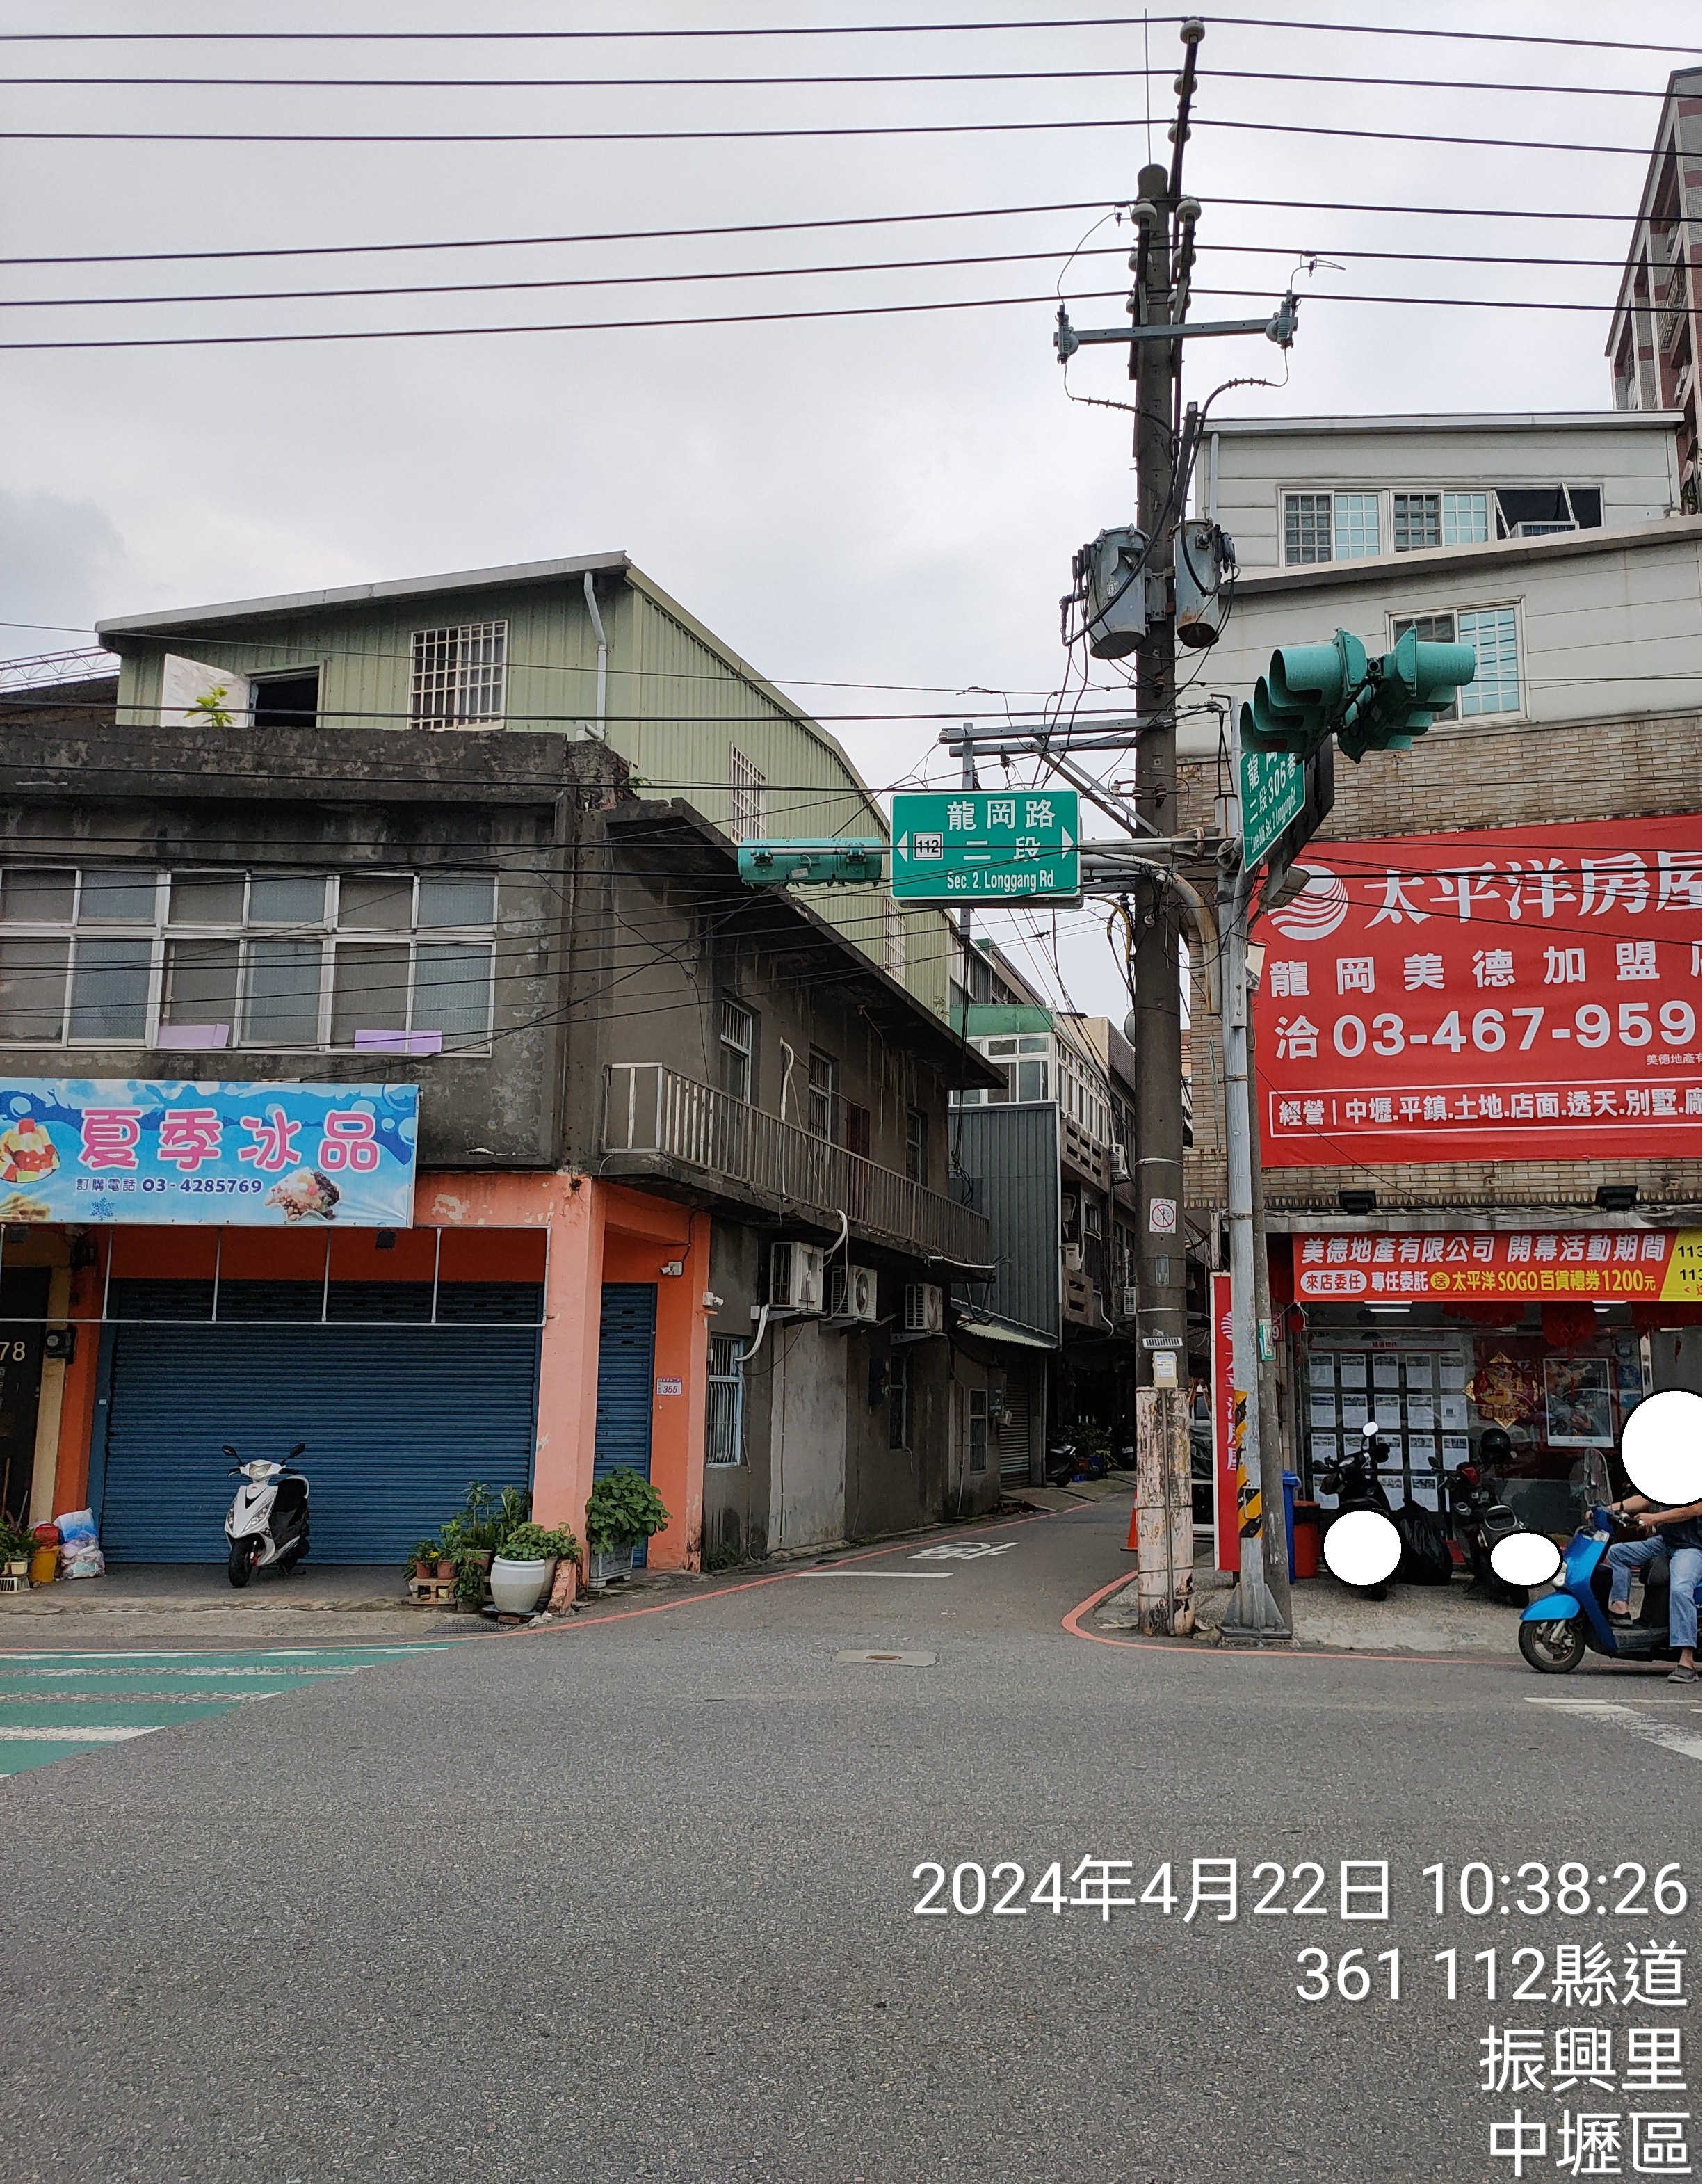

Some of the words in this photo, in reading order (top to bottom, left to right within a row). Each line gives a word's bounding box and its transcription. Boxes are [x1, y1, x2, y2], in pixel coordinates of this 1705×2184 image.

[947, 799, 1056, 830] 龍岡路
[917, 840, 939, 853] 112
[963, 836, 1041, 862] 二段
[947, 872, 969, 890] Sec.
[973, 871, 982, 890] 2,
[985, 871, 1037, 892] Longgang
[1040, 869, 1056, 888] Rd.
[1364, 851, 1702, 929] 太平洋房屋
[1270, 940, 1702, 997] 龍岡美德加盟
[78, 1109, 381, 1173] 夏季冰品
[76, 1178, 136, 1192] 訂購電話
[142, 1178, 264, 1194] 03-4285769
[1301, 1237, 1494, 1264] 美德地產有限公司
[1507, 1235, 1666, 1262] 開幕活動期間
[1306, 1274, 1361, 1291] 來店委任
